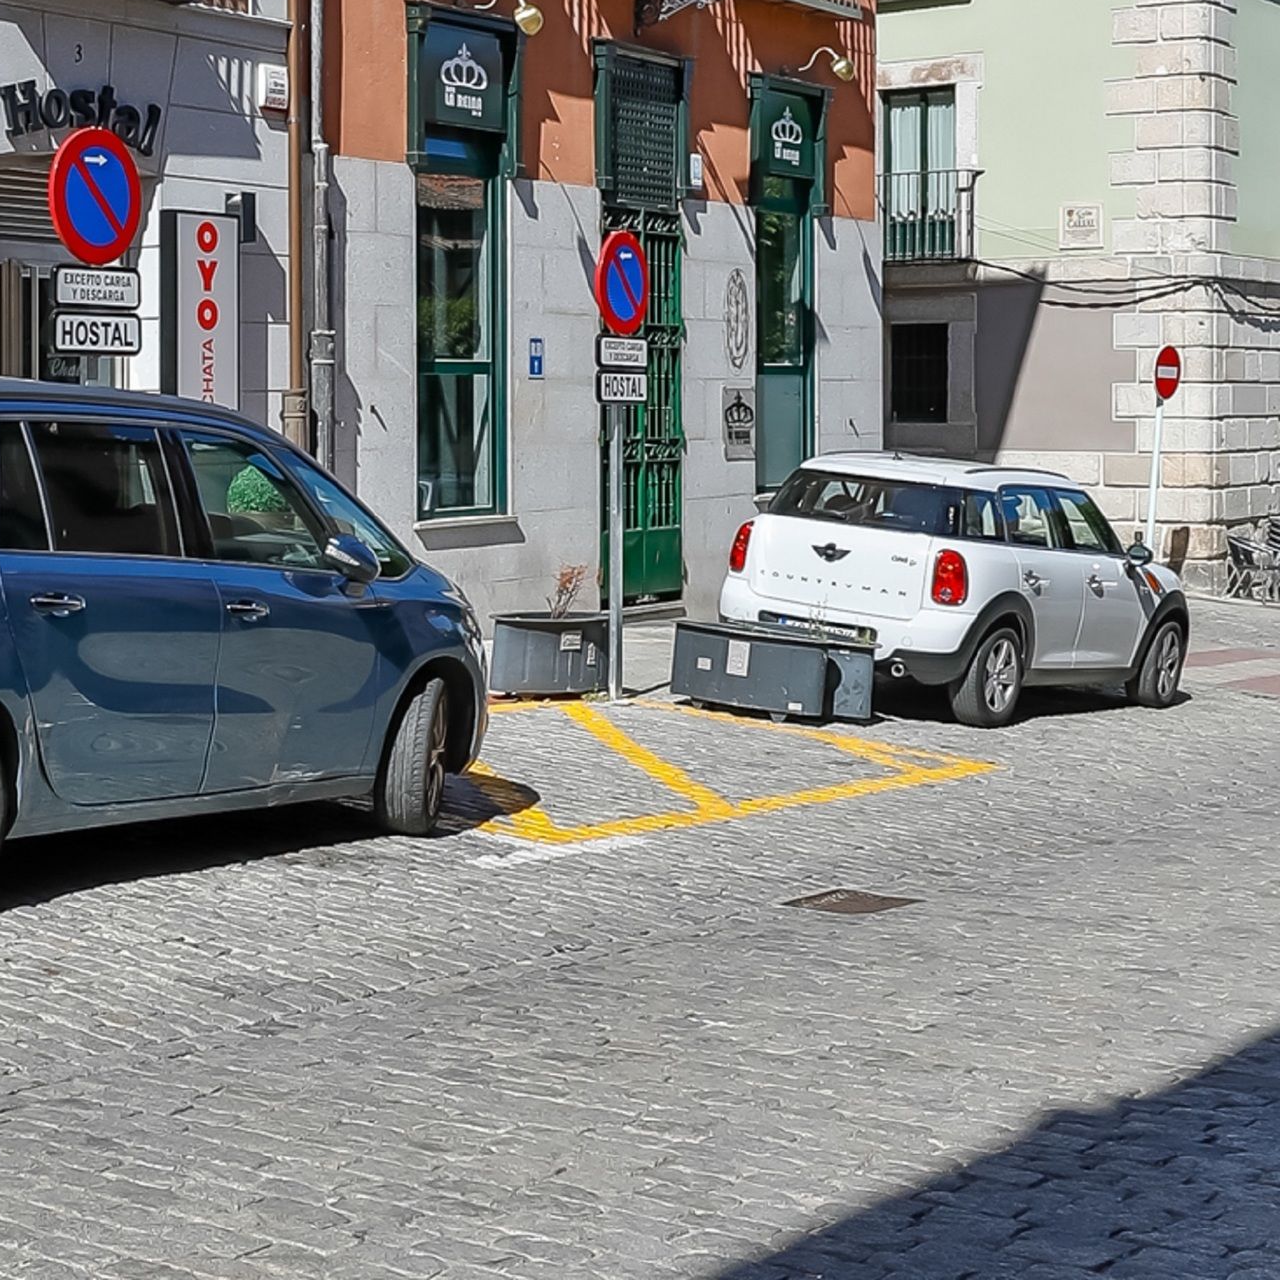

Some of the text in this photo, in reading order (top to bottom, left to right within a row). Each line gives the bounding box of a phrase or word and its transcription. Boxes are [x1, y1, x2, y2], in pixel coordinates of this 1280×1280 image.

[74, 43, 83, 63] 3
[64, 272, 132, 288] EXCEPTO CARGA
[196, 221, 219, 331] OYO
[71, 288, 125, 302] Y DESCARGA
[61, 321, 134, 347] HOSTAL
[604, 376, 644, 397] HOSTAL
[760, 569, 907, 597] COUNTRYMAN
